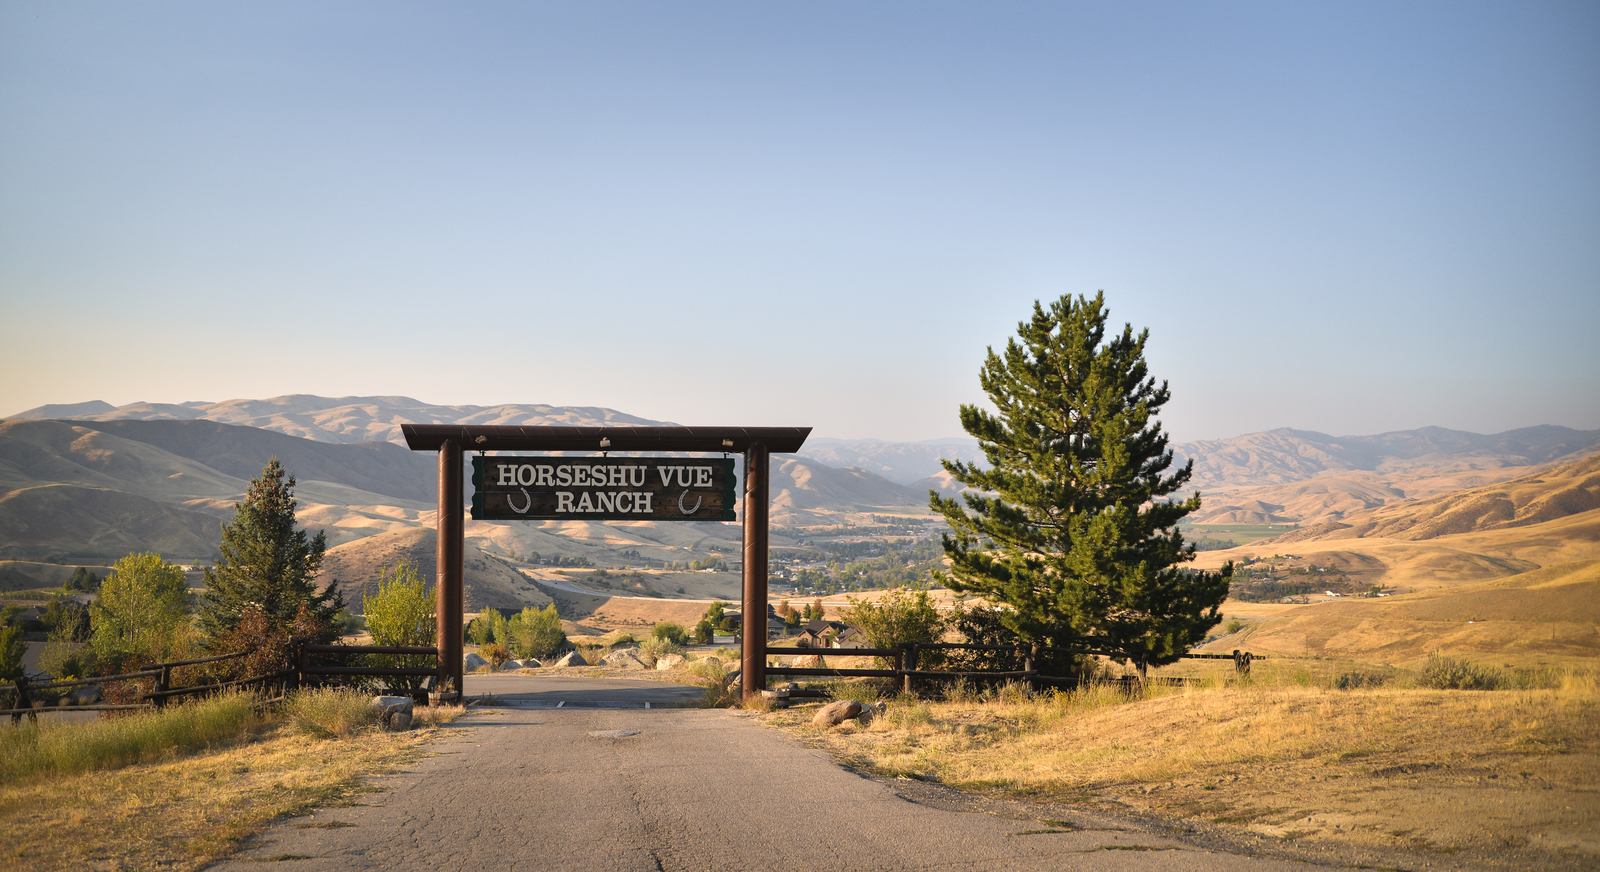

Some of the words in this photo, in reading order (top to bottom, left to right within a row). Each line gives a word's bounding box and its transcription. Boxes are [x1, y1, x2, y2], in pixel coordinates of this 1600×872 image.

[497, 464, 647, 487] HORSESHU
[657, 465, 713, 487] VUE
[555, 491, 653, 513] RANCH
